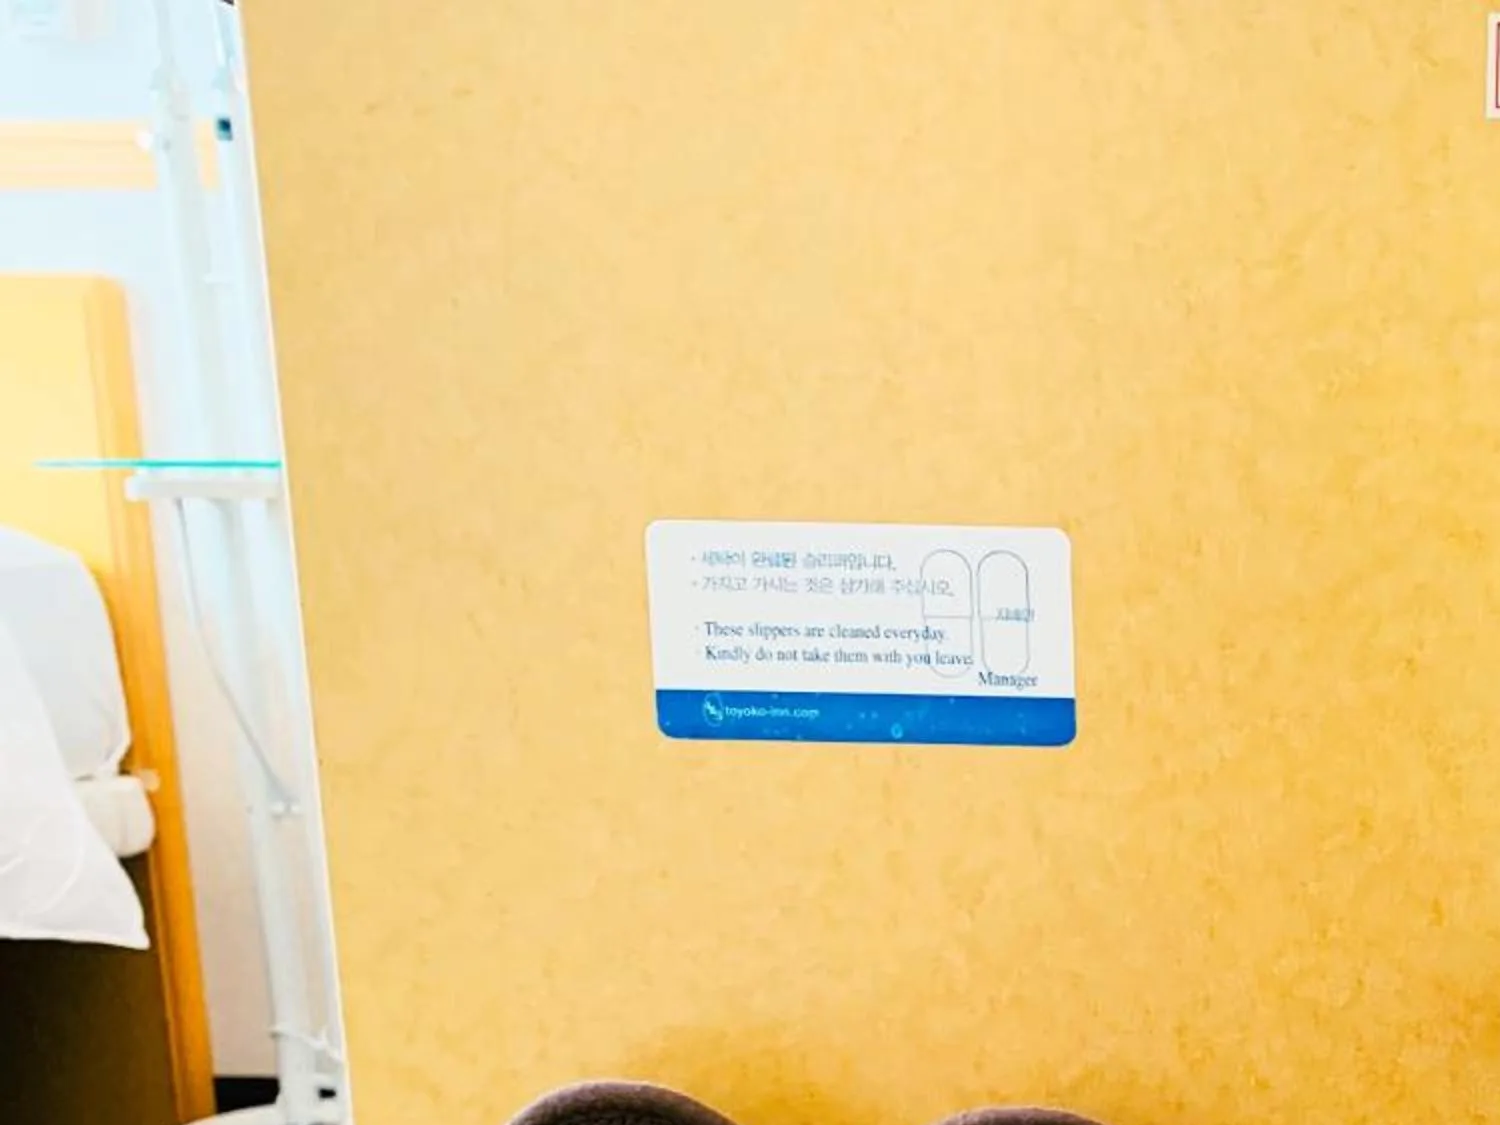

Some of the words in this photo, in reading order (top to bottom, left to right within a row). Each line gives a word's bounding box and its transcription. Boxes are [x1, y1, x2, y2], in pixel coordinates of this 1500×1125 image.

[704, 621, 744, 637] These
[749, 622, 801, 641] slippers
[804, 625, 825, 638] are
[829, 623, 880, 639] cleaned
[705, 645, 750, 665] Kindly
[754, 645, 773, 661] do
[777, 648, 798, 662] not
[802, 647, 831, 663] take
[834, 647, 869, 664] them
[873, 650, 902, 664] with
[906, 652, 931, 669] you
[978, 671, 1039, 692] Manager
